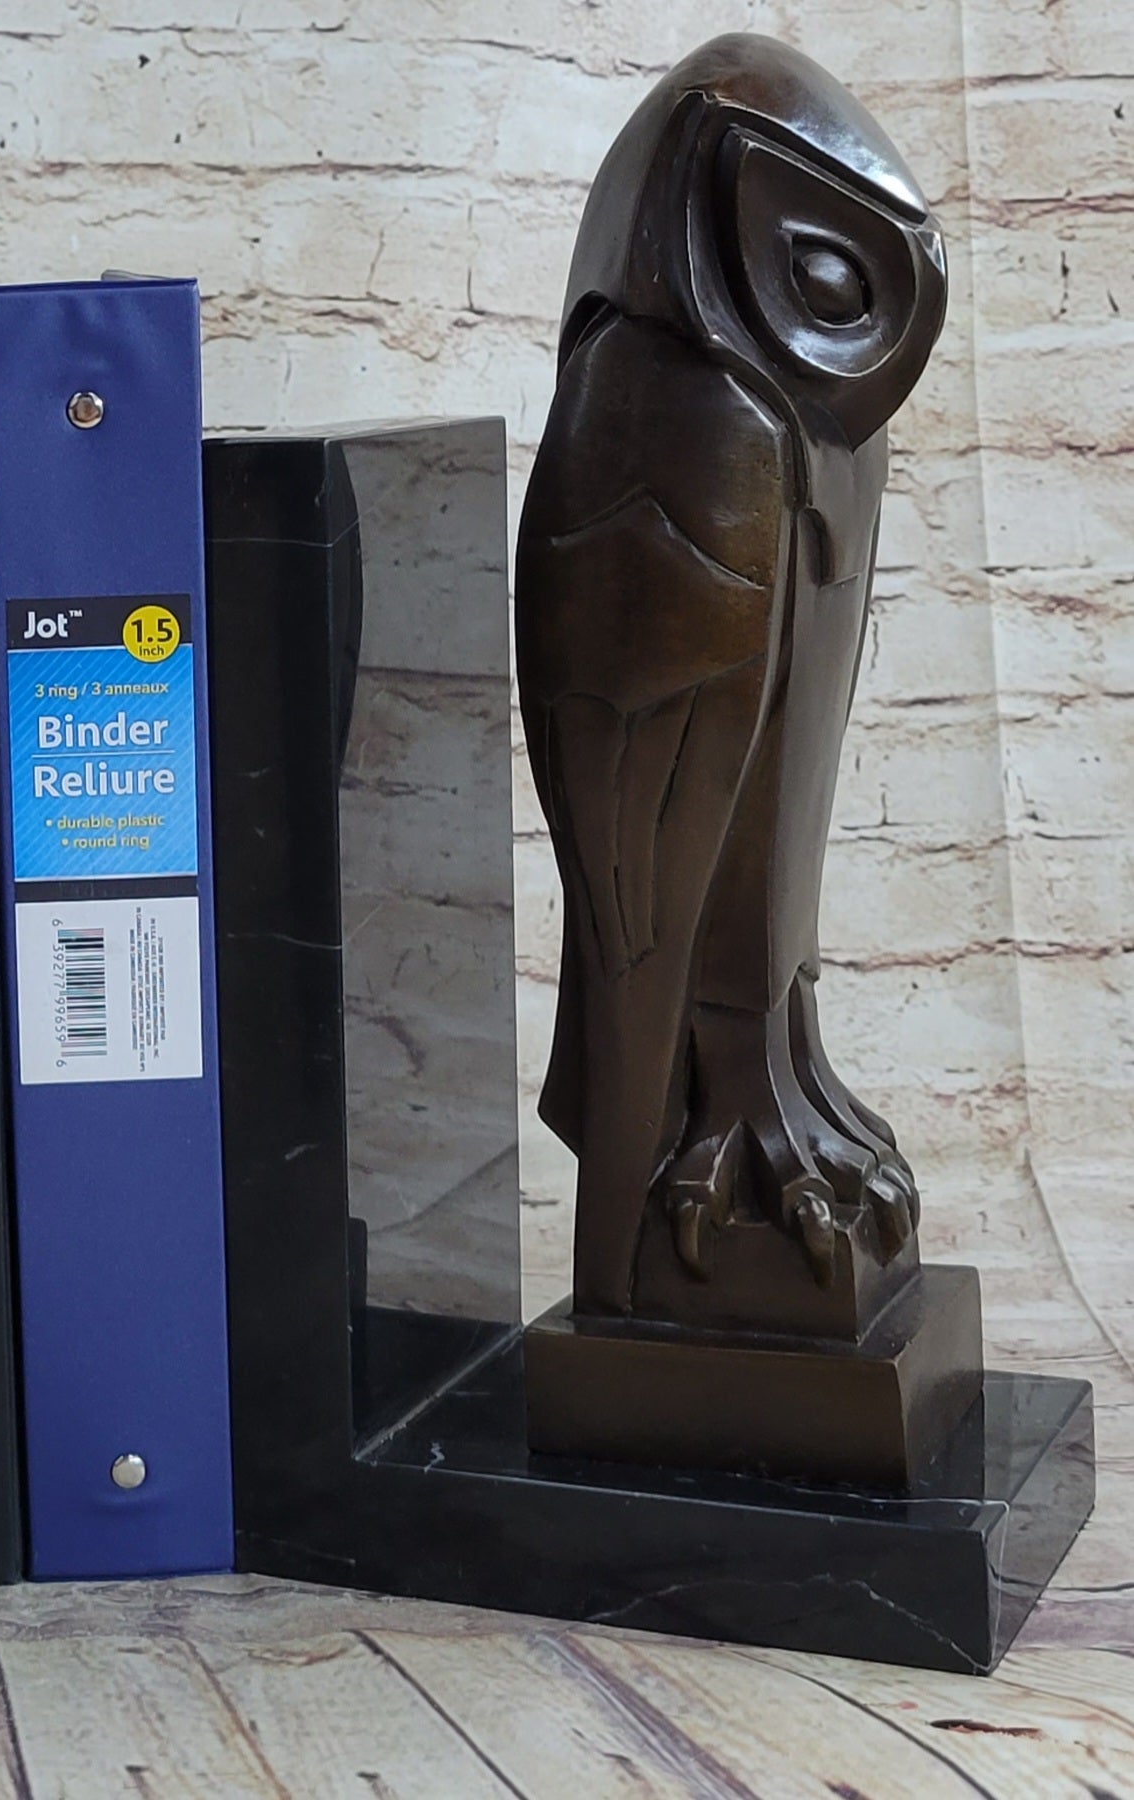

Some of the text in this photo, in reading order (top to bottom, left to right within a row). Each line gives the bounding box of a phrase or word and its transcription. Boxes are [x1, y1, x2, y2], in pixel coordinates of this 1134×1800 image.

[132, 618, 173, 643] 1.5
[139, 645, 164, 657] inch
[35, 684, 44, 697] 3
[49, 683, 78, 699] ring
[92, 681, 101, 695] 3
[105, 682, 169, 695] anneaux
[38, 712, 169, 749] Binder
[34, 762, 175, 798] Reliure
[57, 814, 164, 829] durable plastic
[73, 833, 149, 850] round ring
[52, 944, 65, 988] 39277
[55, 998, 67, 1042] 99659
